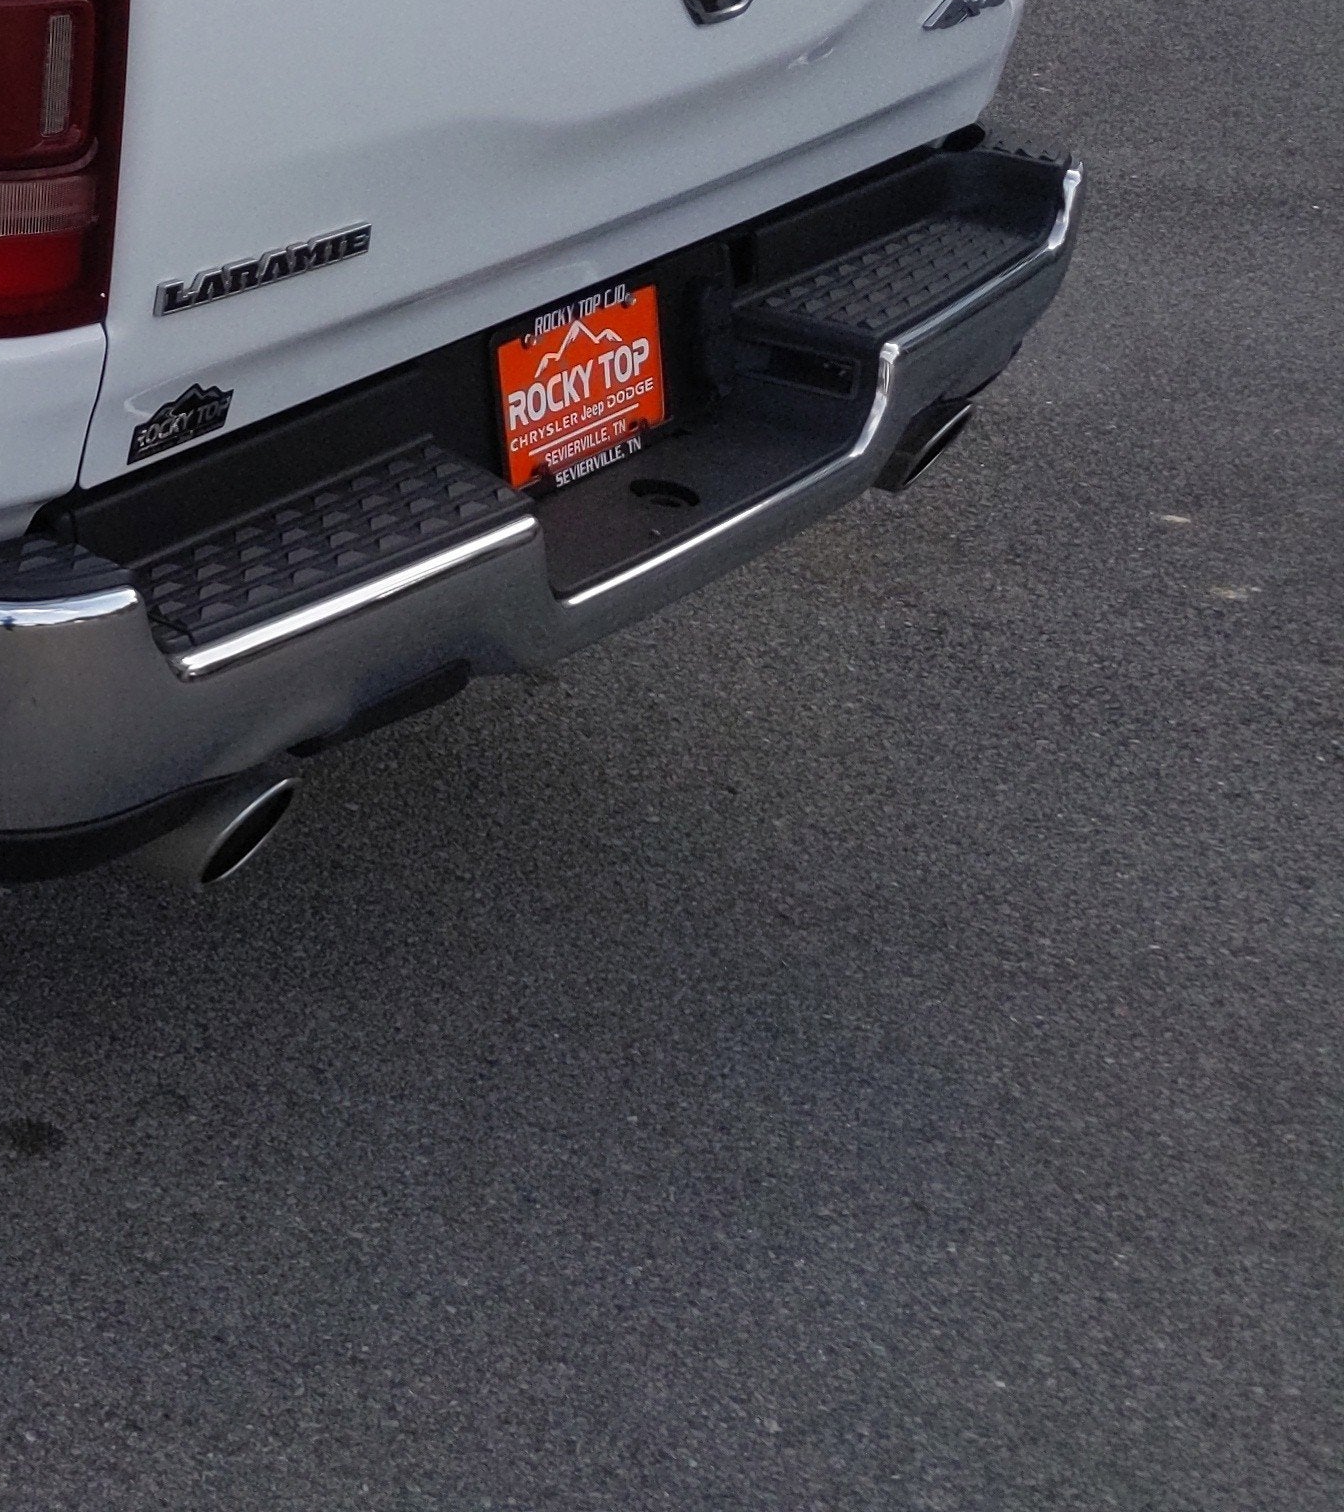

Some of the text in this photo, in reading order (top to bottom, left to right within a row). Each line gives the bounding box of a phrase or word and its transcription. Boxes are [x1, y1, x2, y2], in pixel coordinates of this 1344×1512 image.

[153, 221, 372, 317] LARAMIE
[534, 303, 575, 337] ROCKY
[579, 293, 601, 318] TOP
[508, 337, 650, 430] ROCKY TOP
[510, 377, 654, 452] CHRYSLER Jeep DODGE
[545, 418, 627, 467] SEVIERVILLE, TN
[555, 435, 642, 488] SEVIERVILLE, TN
